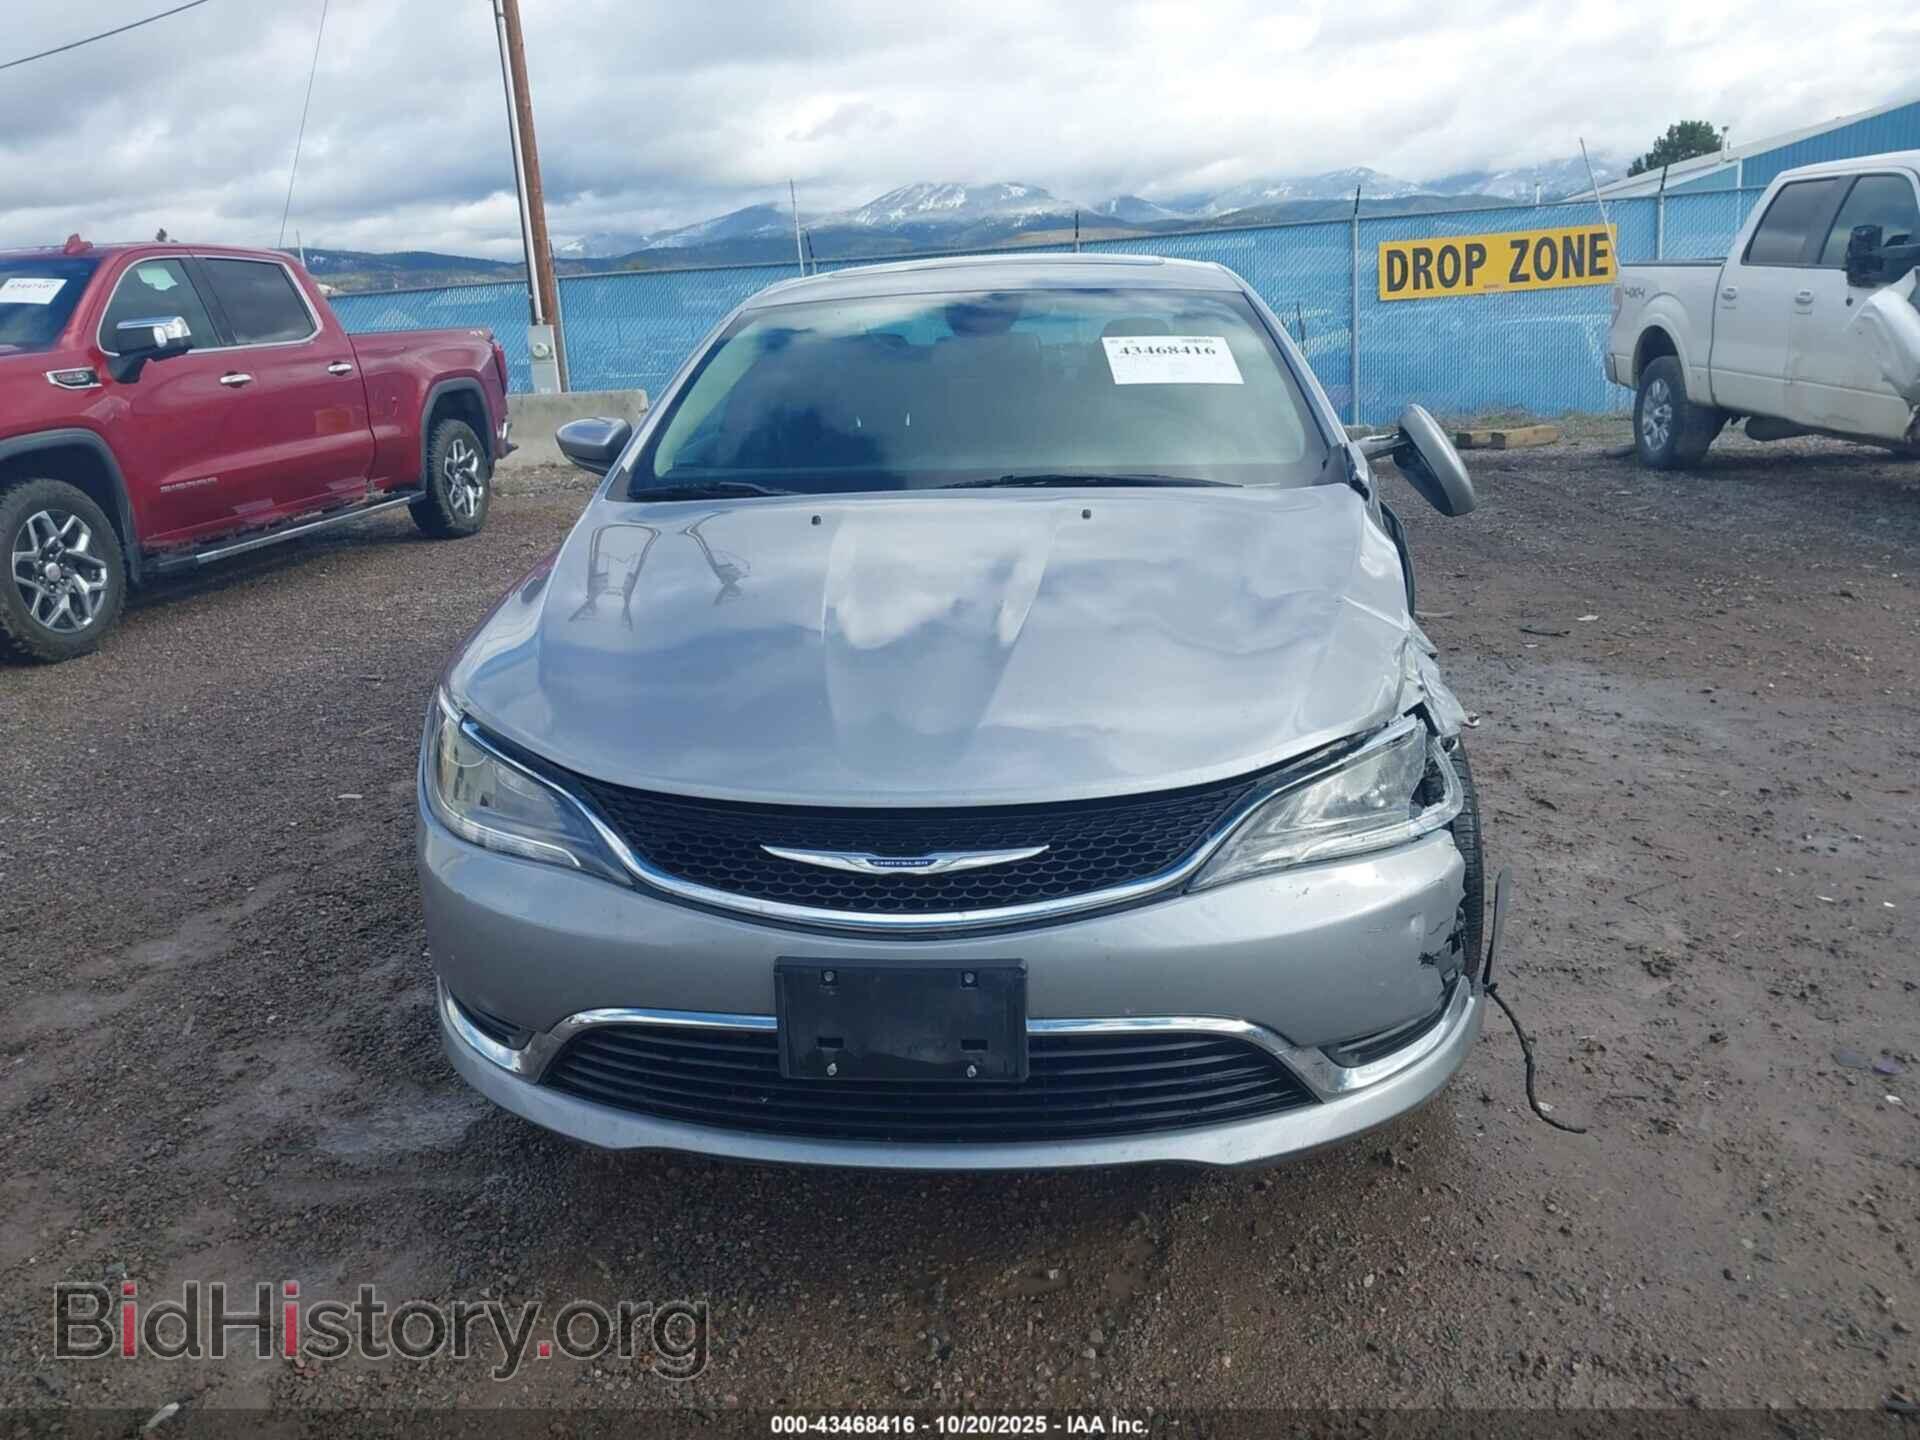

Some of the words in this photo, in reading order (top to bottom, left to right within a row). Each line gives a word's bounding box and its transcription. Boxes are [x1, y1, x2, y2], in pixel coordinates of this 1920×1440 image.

[1386, 243, 1487, 293] DROP
[1508, 232, 1610, 284] ZONE
[1119, 346, 1216, 355] 43468416
